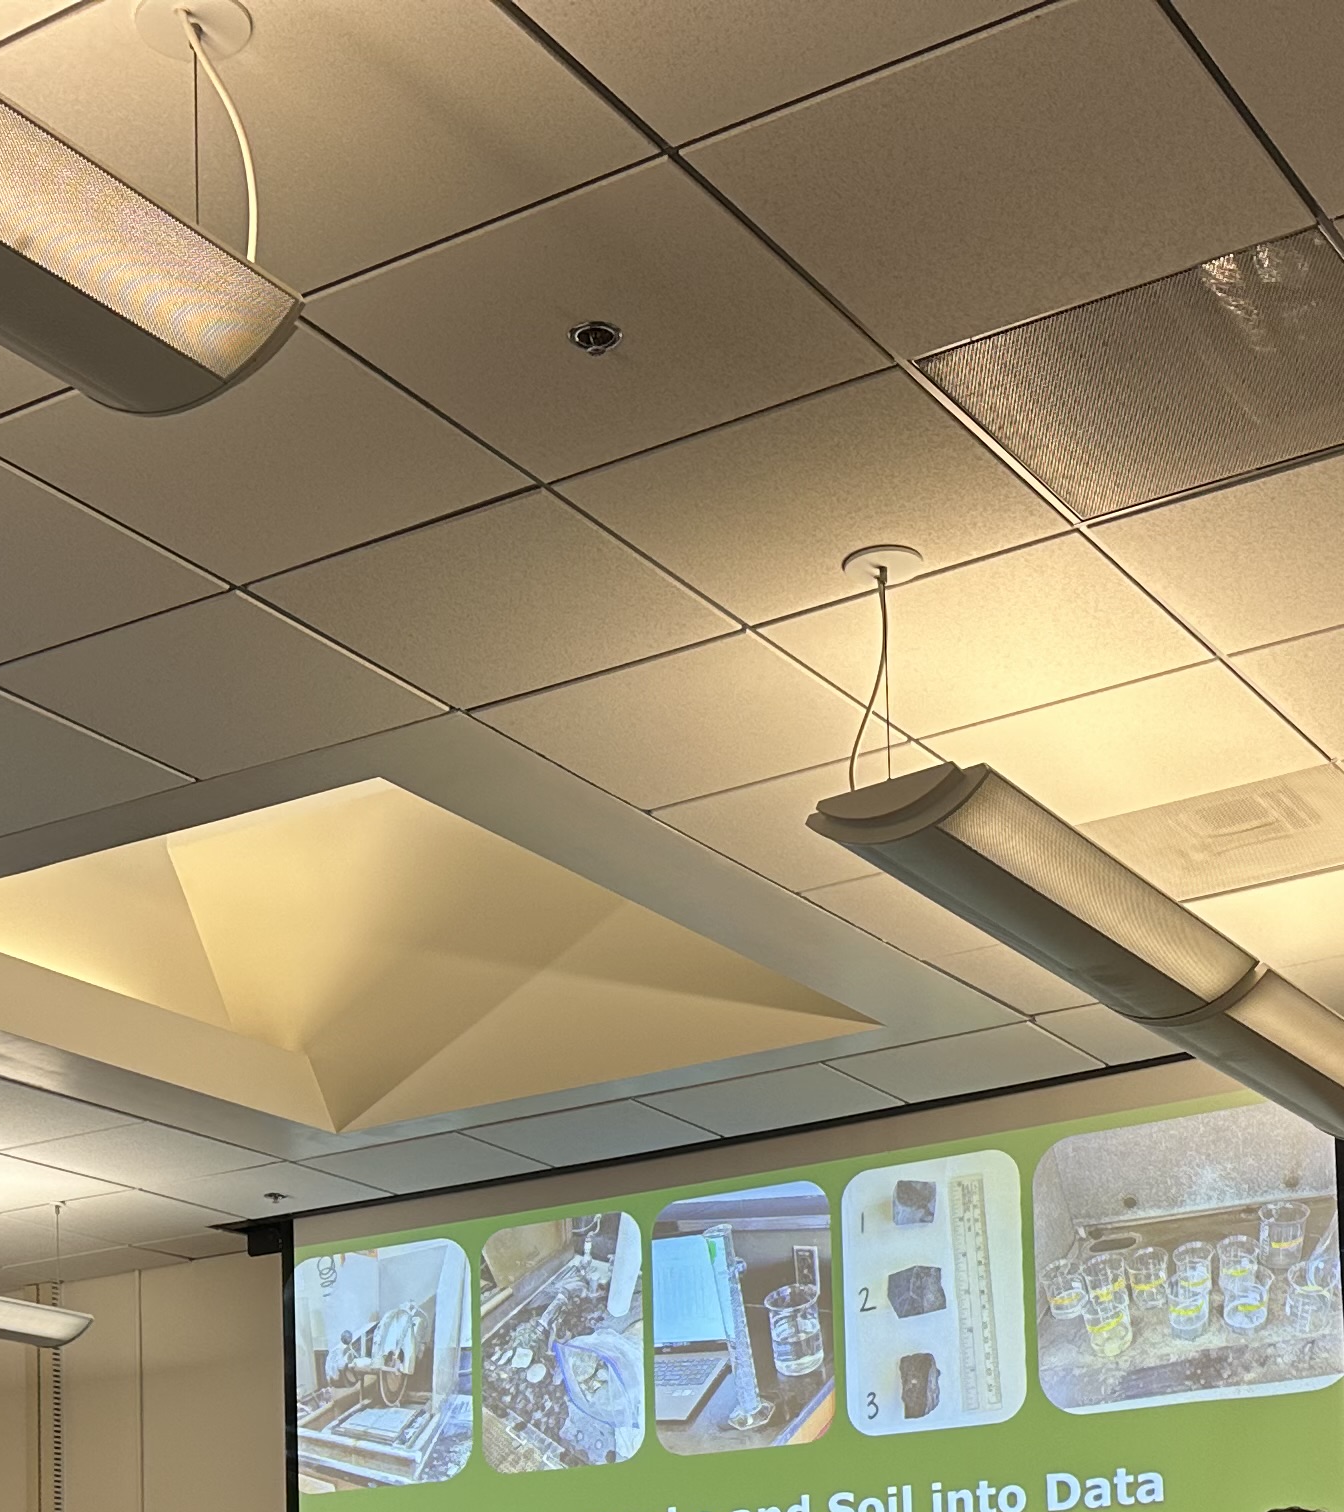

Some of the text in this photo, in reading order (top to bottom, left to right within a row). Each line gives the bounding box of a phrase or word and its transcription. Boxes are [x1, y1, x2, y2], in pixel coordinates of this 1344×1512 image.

[858, 1287, 877, 1312] 2
[866, 1391, 880, 1420] 3
[1045, 1468, 1165, 1512] Data
